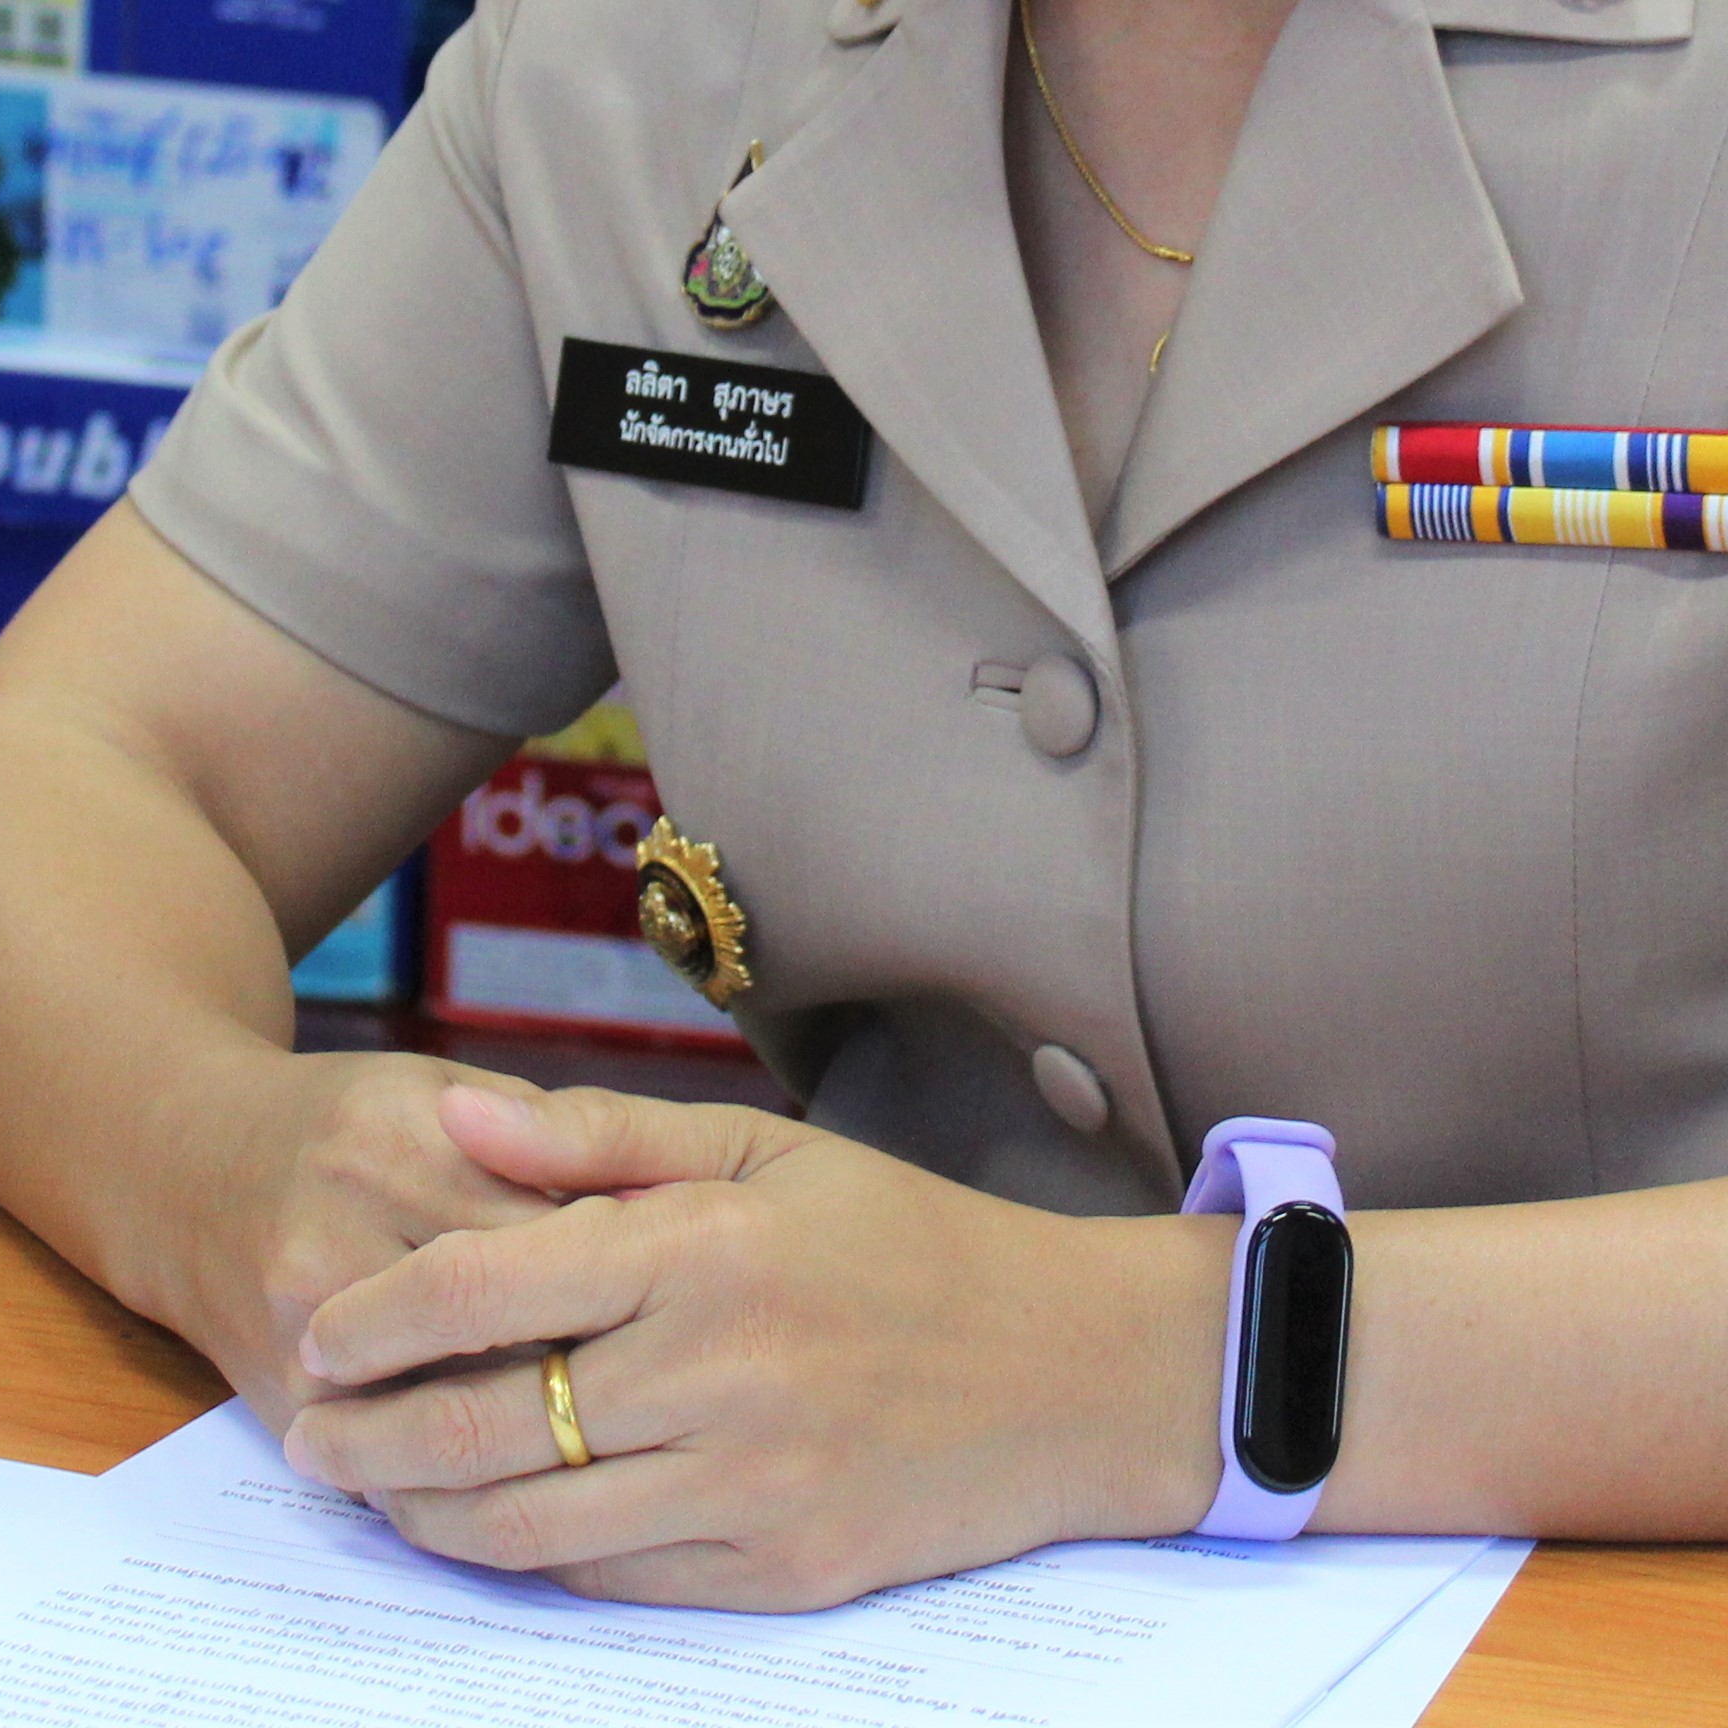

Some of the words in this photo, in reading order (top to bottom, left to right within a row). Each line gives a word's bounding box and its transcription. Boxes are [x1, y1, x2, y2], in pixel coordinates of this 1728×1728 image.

[625, 359, 688, 403] ลลิตา
[619, 408, 790, 467] นักจัดการงานทั่วไป
